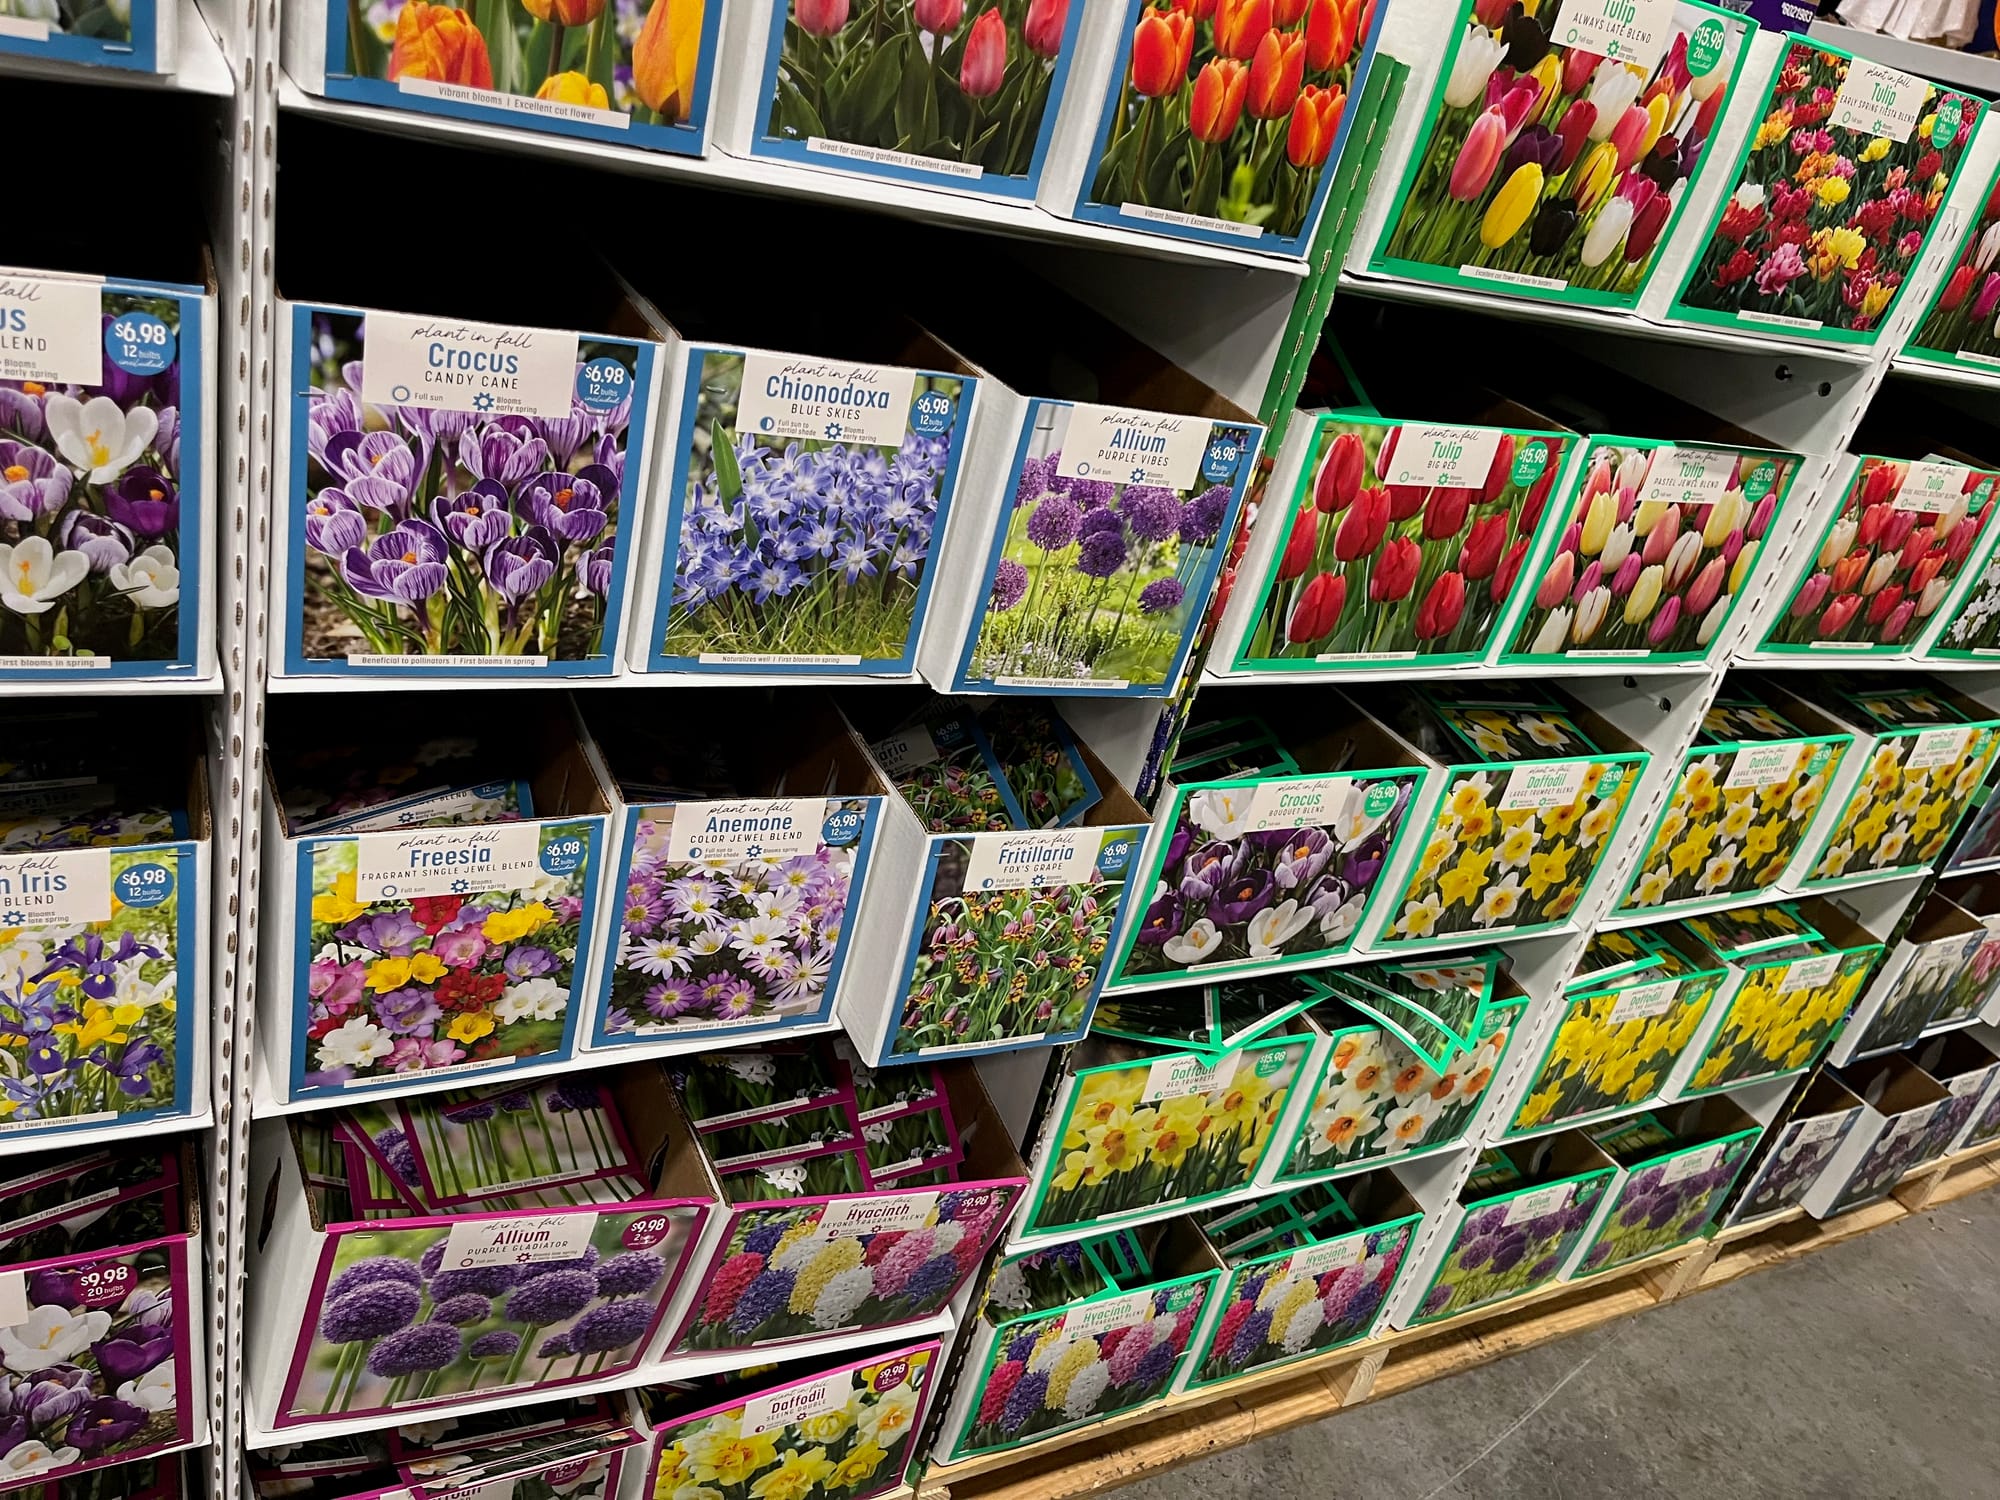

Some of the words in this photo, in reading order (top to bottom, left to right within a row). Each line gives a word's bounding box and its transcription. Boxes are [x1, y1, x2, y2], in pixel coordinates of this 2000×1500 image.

[1603, 0, 1636, 24] Tulip
[1573, 12, 1603, 29] ALWAYS
[1606, 22, 1625, 36] LATE
[1626, 27, 1651, 43] BLEND
[1695, 26, 1724, 50] $15.98
[439, 86, 470, 100] Vibrant
[472, 92, 503, 105] blooms
[514, 99, 552, 114] Excellent
[554, 105, 568, 116] cut
[569, 109, 596, 120] flower
[1871, 83, 1897, 109] Tulip
[820, 142, 837, 151] Great
[850, 147, 874, 159] cutting
[875, 152, 901, 163] gardens
[910, 158, 940, 169] Excellent
[952, 165, 972, 174] flower
[115, 322, 166, 345] $6.98
[410, 323, 468, 340] plant
[470, 331, 492, 343] in
[494, 331, 532, 350] fall
[123, 345, 137, 358] 12
[138, 351, 161, 359] bulbs
[428, 342, 519, 374] Crocus
[4, 359, 36, 368] Blooms
[4, 368, 29, 378] early
[30, 370, 58, 379] spring
[425, 371, 474, 386] CANDY
[481, 375, 519, 390] CANE
[585, 366, 624, 385] $6.98
[780, 362, 828, 377] plant
[829, 369, 846, 378] in
[847, 369, 878, 384] fall
[414, 392, 427, 400] Full
[590, 383, 599, 395] 12
[600, 389, 618, 397] bulbs
[766, 375, 890, 409] Chionodoxa
[496, 396, 522, 405] Blooms
[918, 398, 949, 415] $6.98
[496, 404, 514, 412] early
[515, 405, 537, 414] spring
[792, 404, 821, 417] BLUE
[827, 407, 861, 420] SKIES
[1100, 412, 1139, 427] plant
[1141, 420, 1155, 428] in
[1155, 419, 1182, 433] fall
[1110, 428, 1167, 453] Allium
[1421, 428, 1449, 439] plant
[1459, 431, 1479, 442] fall
[1098, 450, 1136, 463] PURPLE
[1141, 455, 1169, 467] VIBES
[1210, 446, 1237, 462] $6.98
[1431, 441, 1463, 460] Tulip
[1519, 448, 1548, 463] $15.98
[1427, 460, 1440, 469] BIG
[1443, 461, 1457, 469] RED
[1679, 462, 1705, 480] Tulip
[1654, 478, 1676, 487] PASTEL
[1699, 481, 1719, 489] BLEND
[411, 657, 450, 666] pollinators
[513, 658, 535, 666] spring
[1527, 774, 1567, 788] Daffodil
[1280, 794, 1321, 807] Crocus
[1370, 785, 1396, 800] $15.98
[707, 804, 747, 816] plant
[766, 802, 793, 813] fall
[1269, 808, 1301, 816] BOUQUET
[706, 816, 792, 832] Anemone
[829, 815, 857, 828] $6.98
[397, 835, 445, 850] plant
[448, 835, 466, 845] in
[468, 830, 501, 848] fall
[690, 835, 725, 844] COLOR
[730, 833, 765, 842] JEWEL
[769, 832, 803, 841] BLEND
[1001, 837, 1035, 849] plant
[1037, 836, 1050, 844] in
[1051, 833, 1075, 846] fall
[410, 845, 491, 868] Freesia
[547, 841, 580, 857] $6.98
[999, 846, 1074, 864] Fritillaria
[1104, 844, 1128, 856] $6.98
[551, 857, 560, 866] 12
[1004, 864, 1030, 873] FOX'S
[1034, 863, 1063, 871] GRAPE
[122, 869, 166, 886] $6.98
[362, 870, 417, 881] FRAGRANT
[422, 866, 459, 877] SINGLE
[464, 864, 497, 874] JEWEL
[501, 860, 533, 870] BLEND
[22, 871, 68, 893] Iris
[129, 888, 141, 896] 12
[4, 895, 54, 907] BLEND
[962, 1196, 989, 1207] $9.98
[847, 1204, 910, 1221] Hyacinth
[630, 1219, 665, 1233] $9.98
[492, 1230, 550, 1246] Allium
[468, 1245, 507, 1255] PURPLE
[512, 1241, 569, 1251] GLADIATOR
[80, 1266, 128, 1287] $9.98
[87, 1287, 103, 1297] 20
[104, 1285, 124, 1294] bulbs
[1083, 1303, 1132, 1323] Hyacinth
[879, 1364, 906, 1379] $9.98
[771, 1388, 826, 1414] Daffodil
